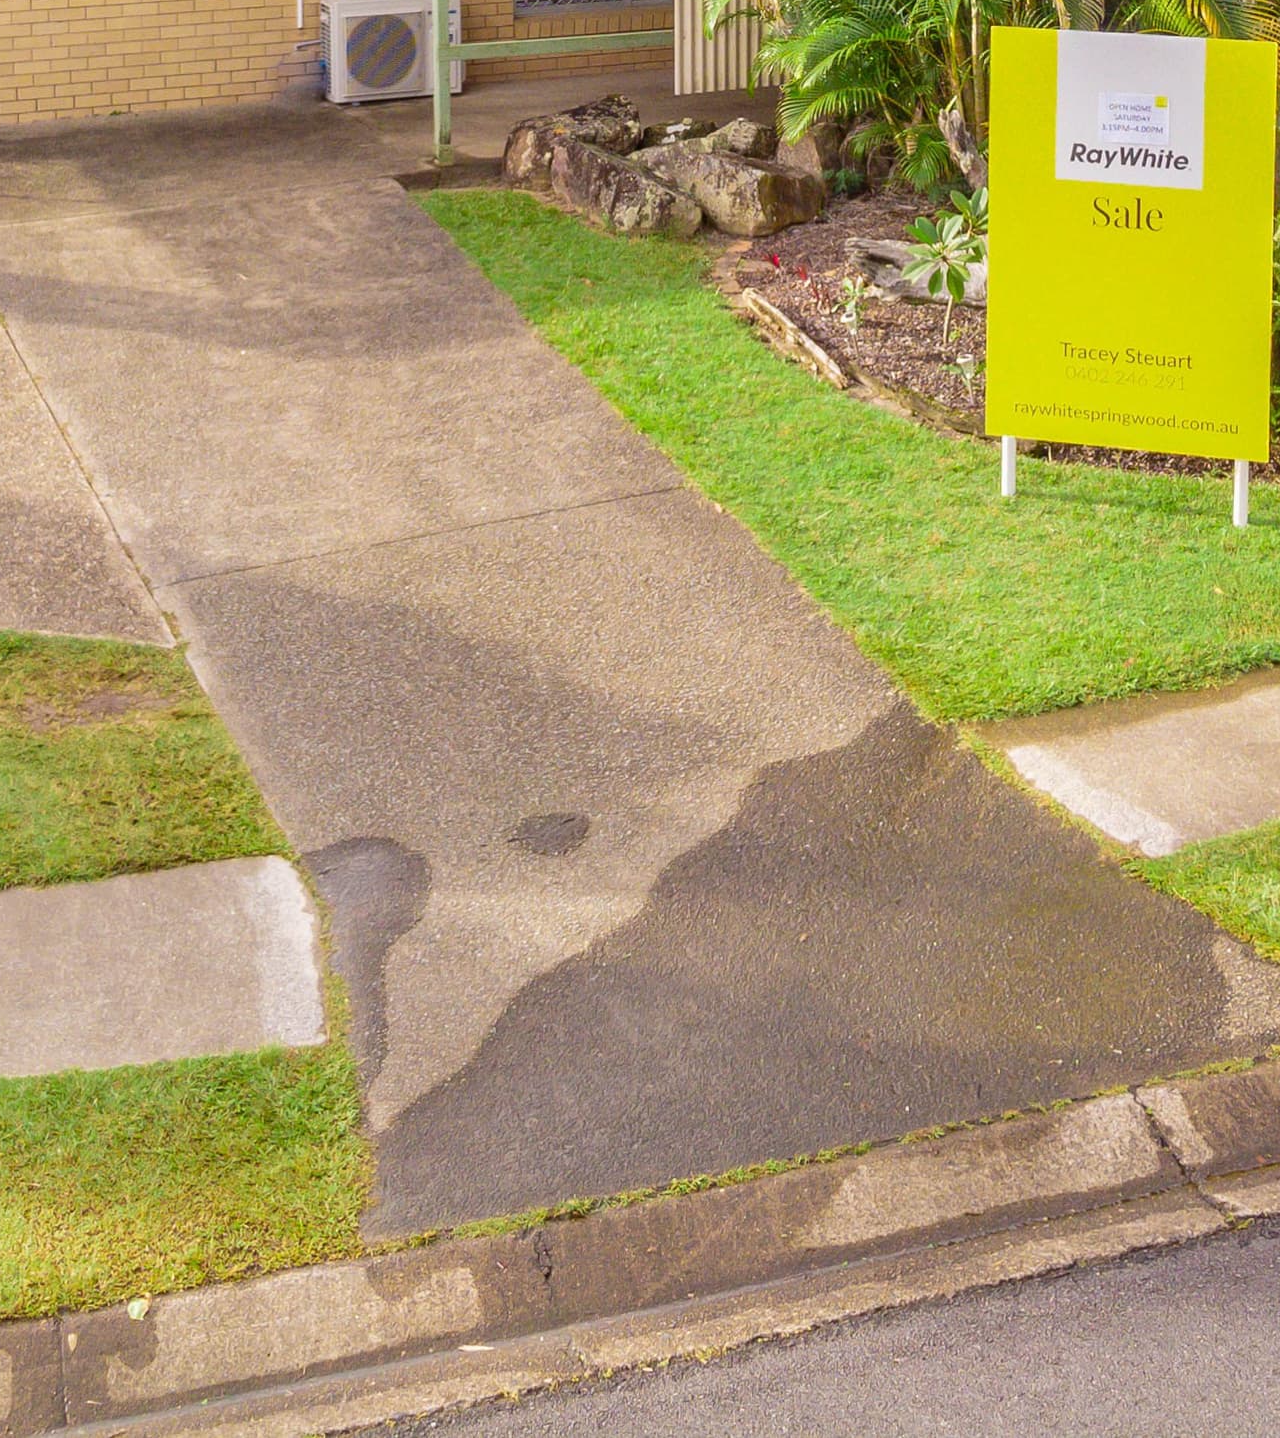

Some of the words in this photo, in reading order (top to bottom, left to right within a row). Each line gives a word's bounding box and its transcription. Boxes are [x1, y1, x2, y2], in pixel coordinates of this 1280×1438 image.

[1092, 196, 1163, 232] Sale
[1059, 341, 1119, 365] Tracey
[1125, 348, 1193, 369] Steuart
[1014, 402, 1239, 435] raywhitespringwood.com.au
